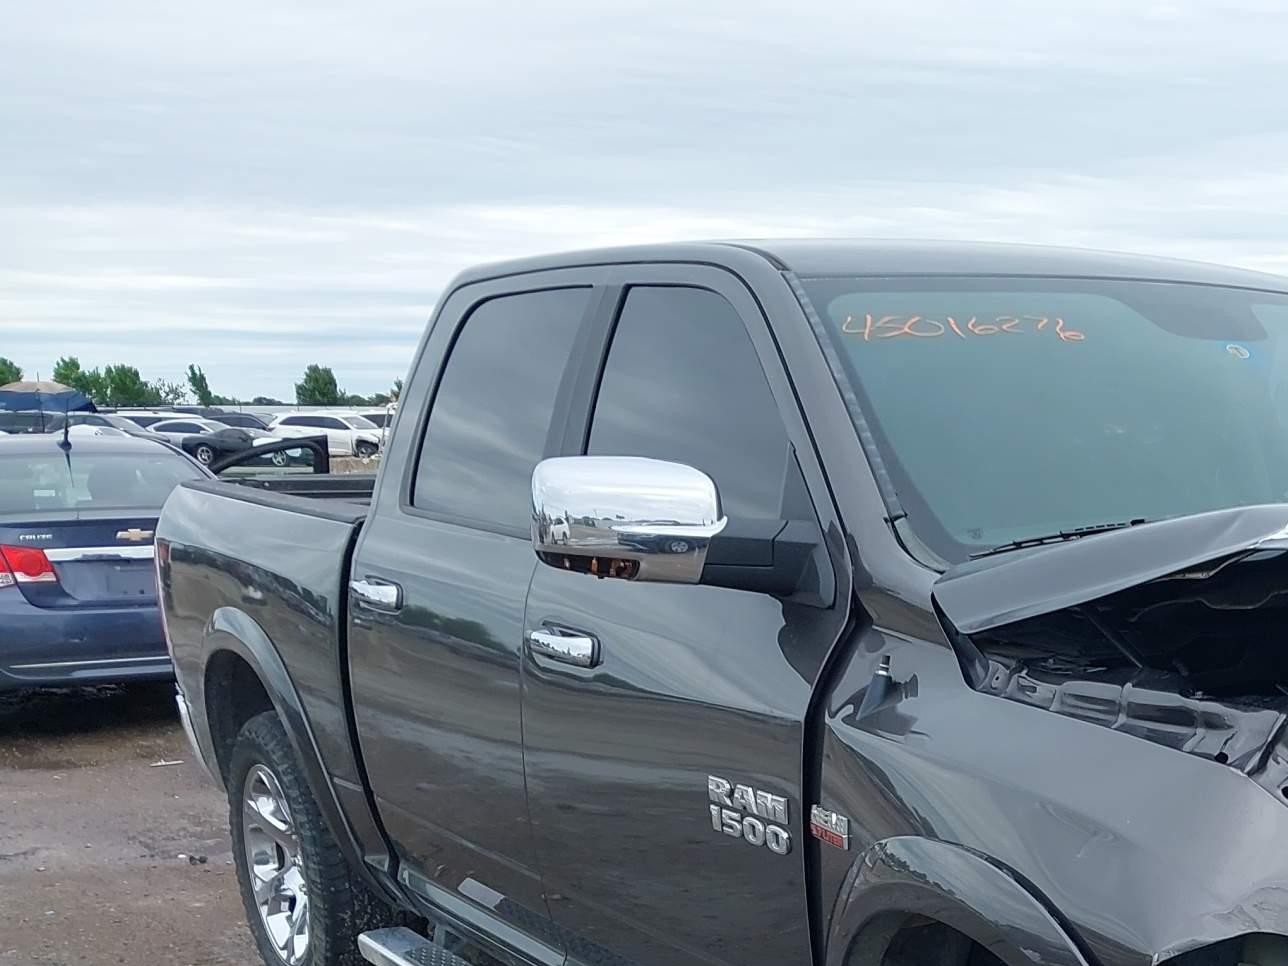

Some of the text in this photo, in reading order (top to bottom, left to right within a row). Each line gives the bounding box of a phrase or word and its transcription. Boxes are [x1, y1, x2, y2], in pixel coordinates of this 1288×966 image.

[842, 314, 1085, 341] 45016276
[708, 775, 789, 825] RAM
[709, 803, 792, 855] 1500
